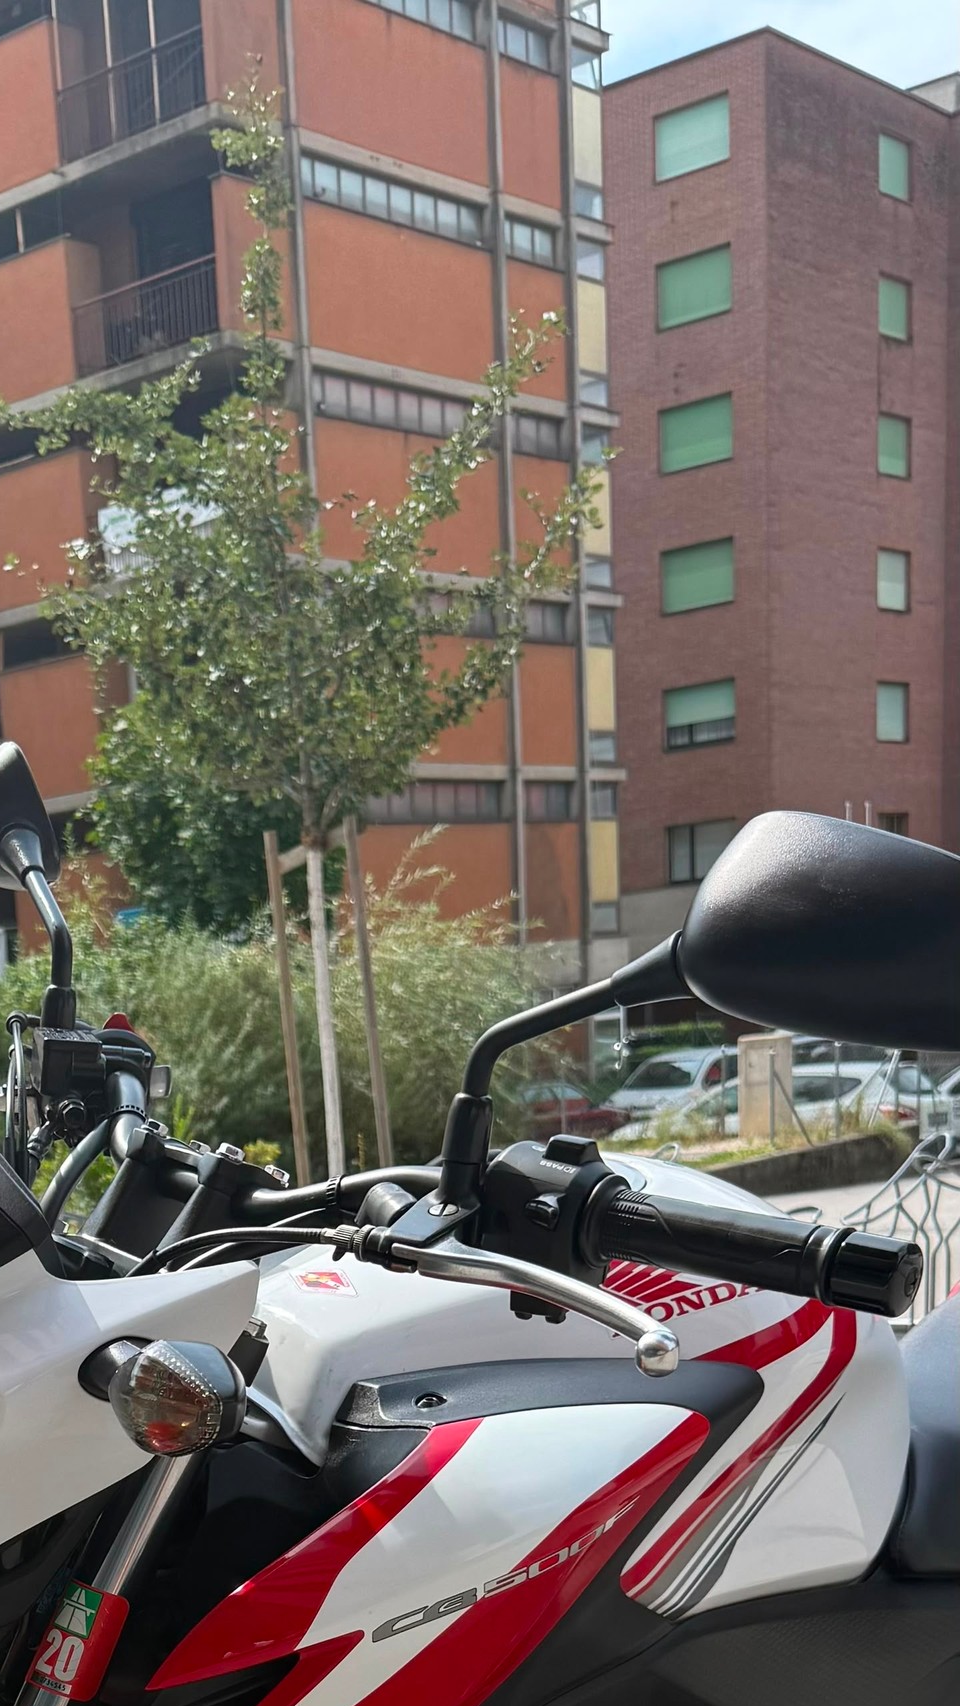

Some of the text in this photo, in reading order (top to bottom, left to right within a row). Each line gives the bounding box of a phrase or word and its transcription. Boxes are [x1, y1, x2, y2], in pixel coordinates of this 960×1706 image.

[613, 1282, 766, 1337] OND
[372, 1494, 640, 1643] CB500F
[35, 1628, 85, 1682] 20
